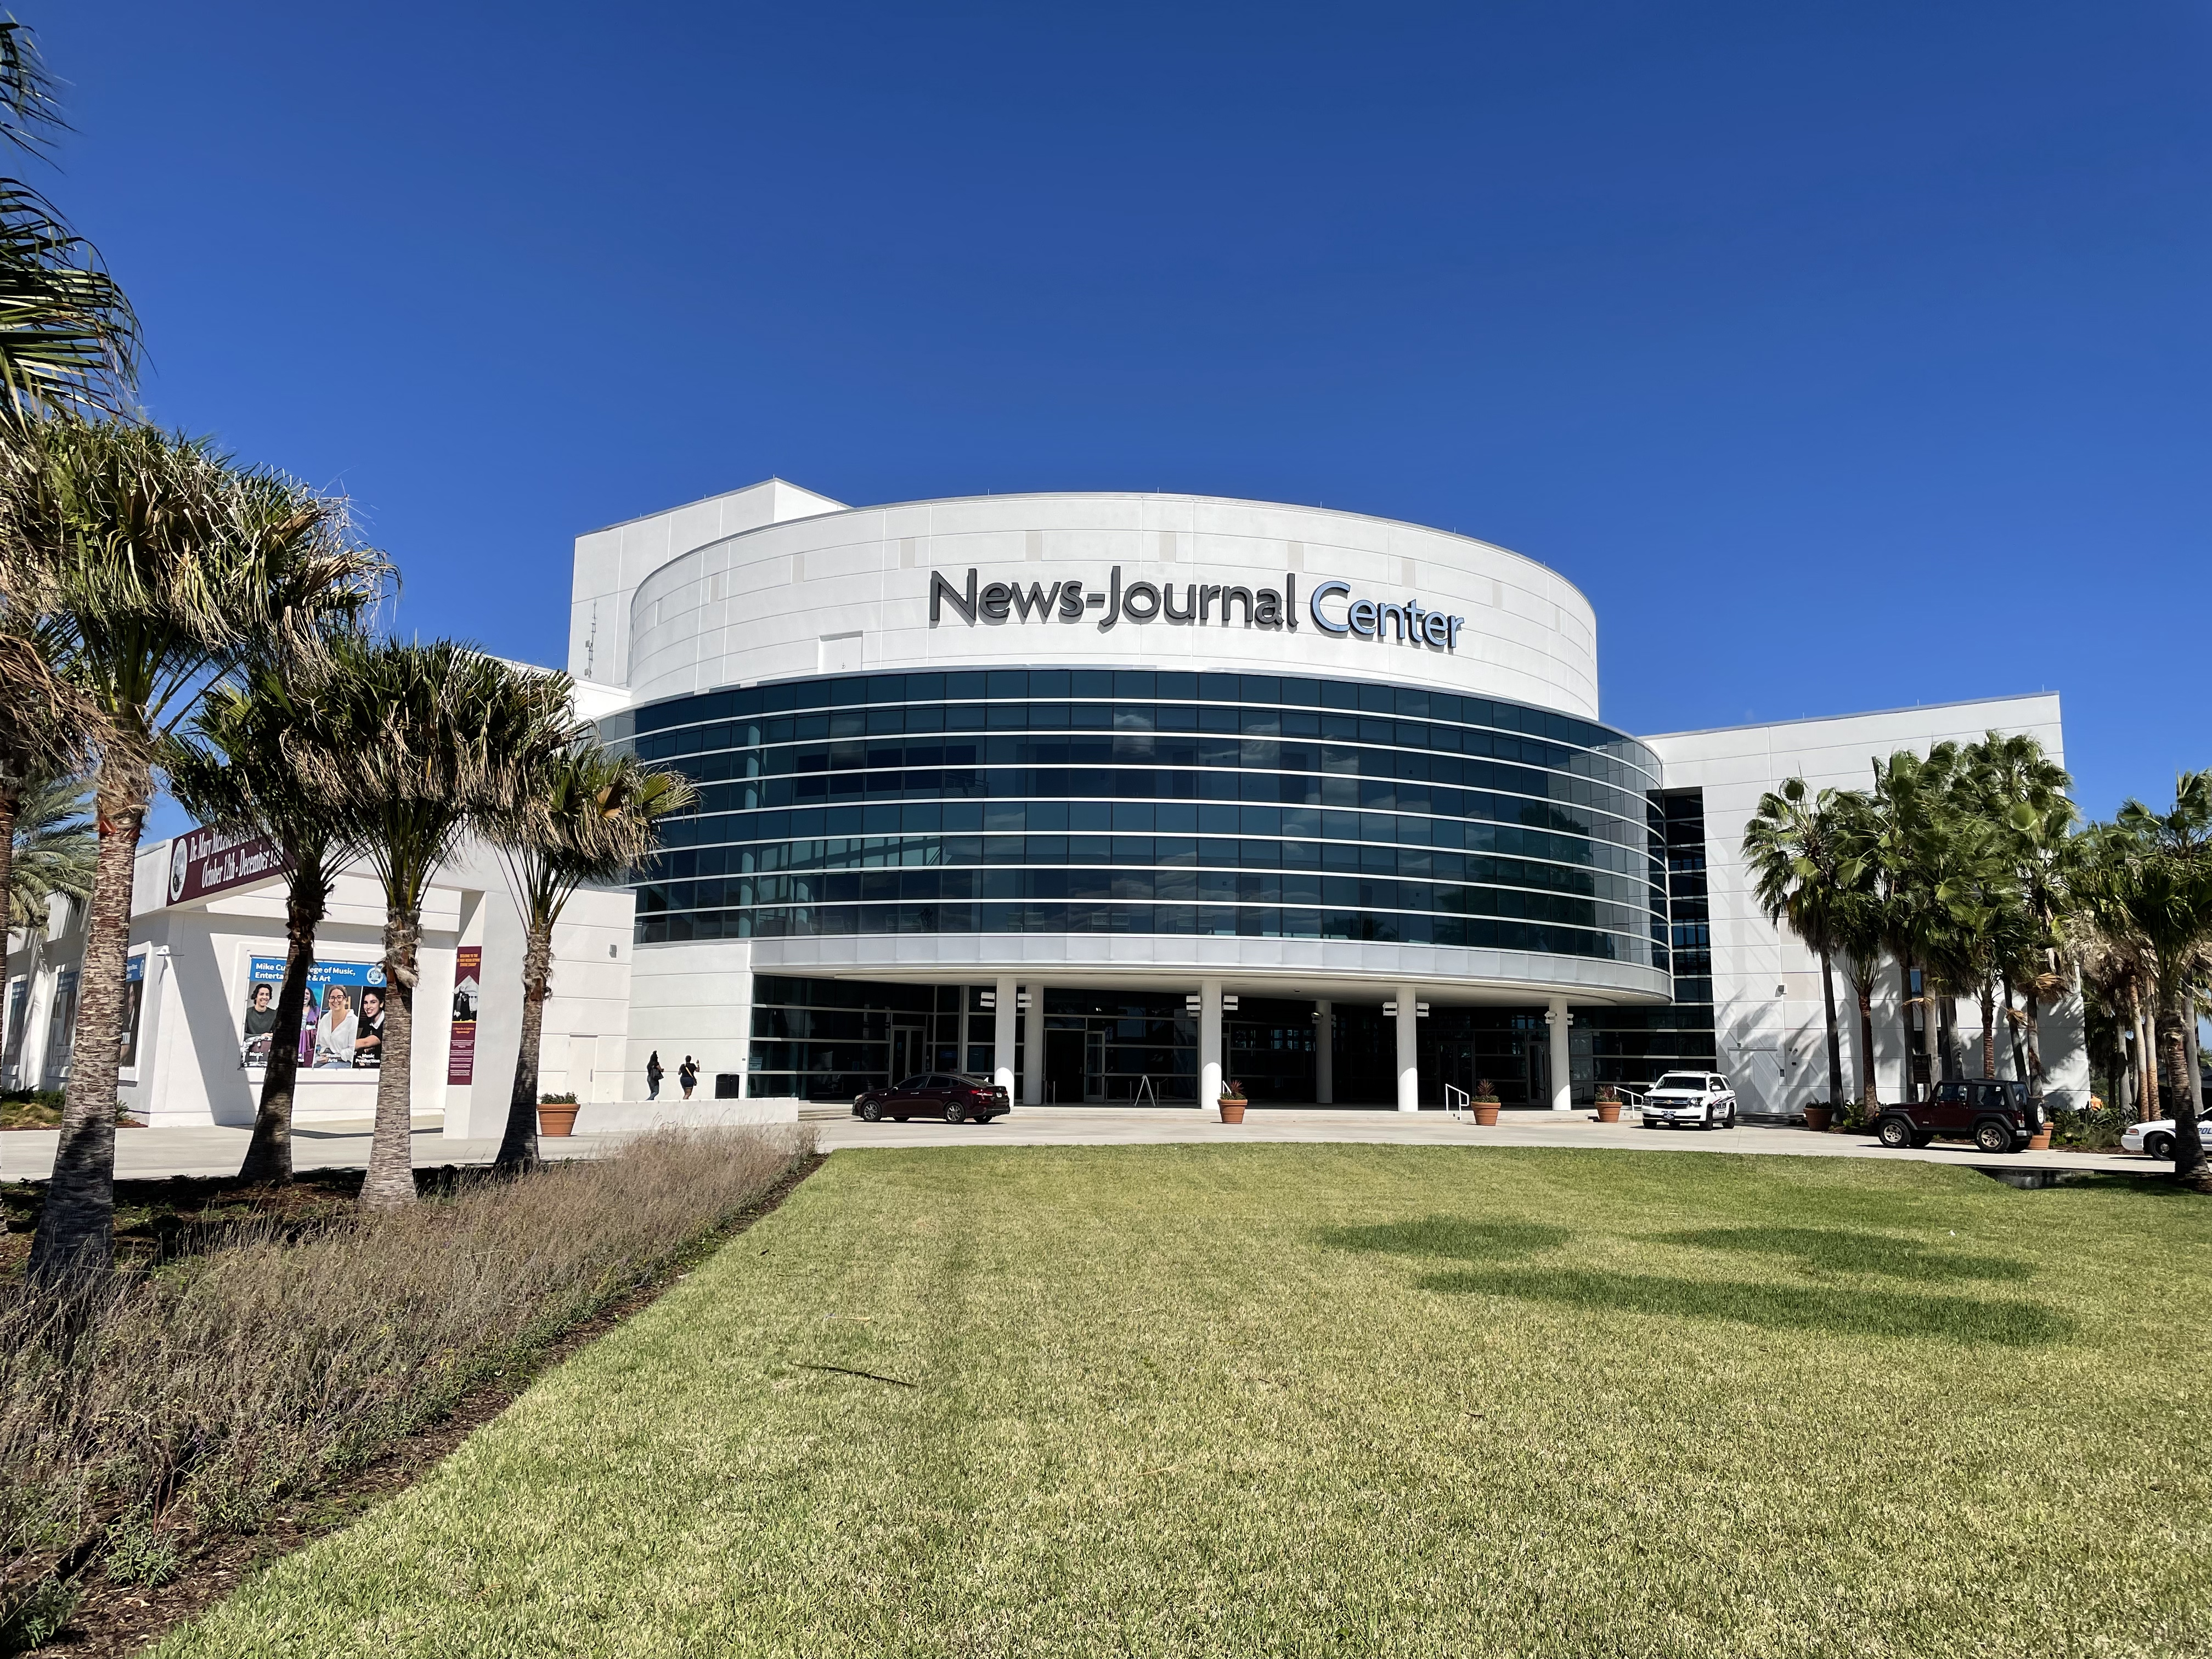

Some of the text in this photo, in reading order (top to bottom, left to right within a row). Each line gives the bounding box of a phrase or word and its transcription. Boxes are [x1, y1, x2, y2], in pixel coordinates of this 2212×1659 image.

[929, 566, 1465, 649] News-Journal Center
[189, 837, 198, 863] Dr.
[198, 833, 212, 864] Mary
[201, 857, 223, 888] October
[223, 851, 236, 882] 12th
[238, 844, 270, 877] December
[332, 967, 356, 977] Music,
